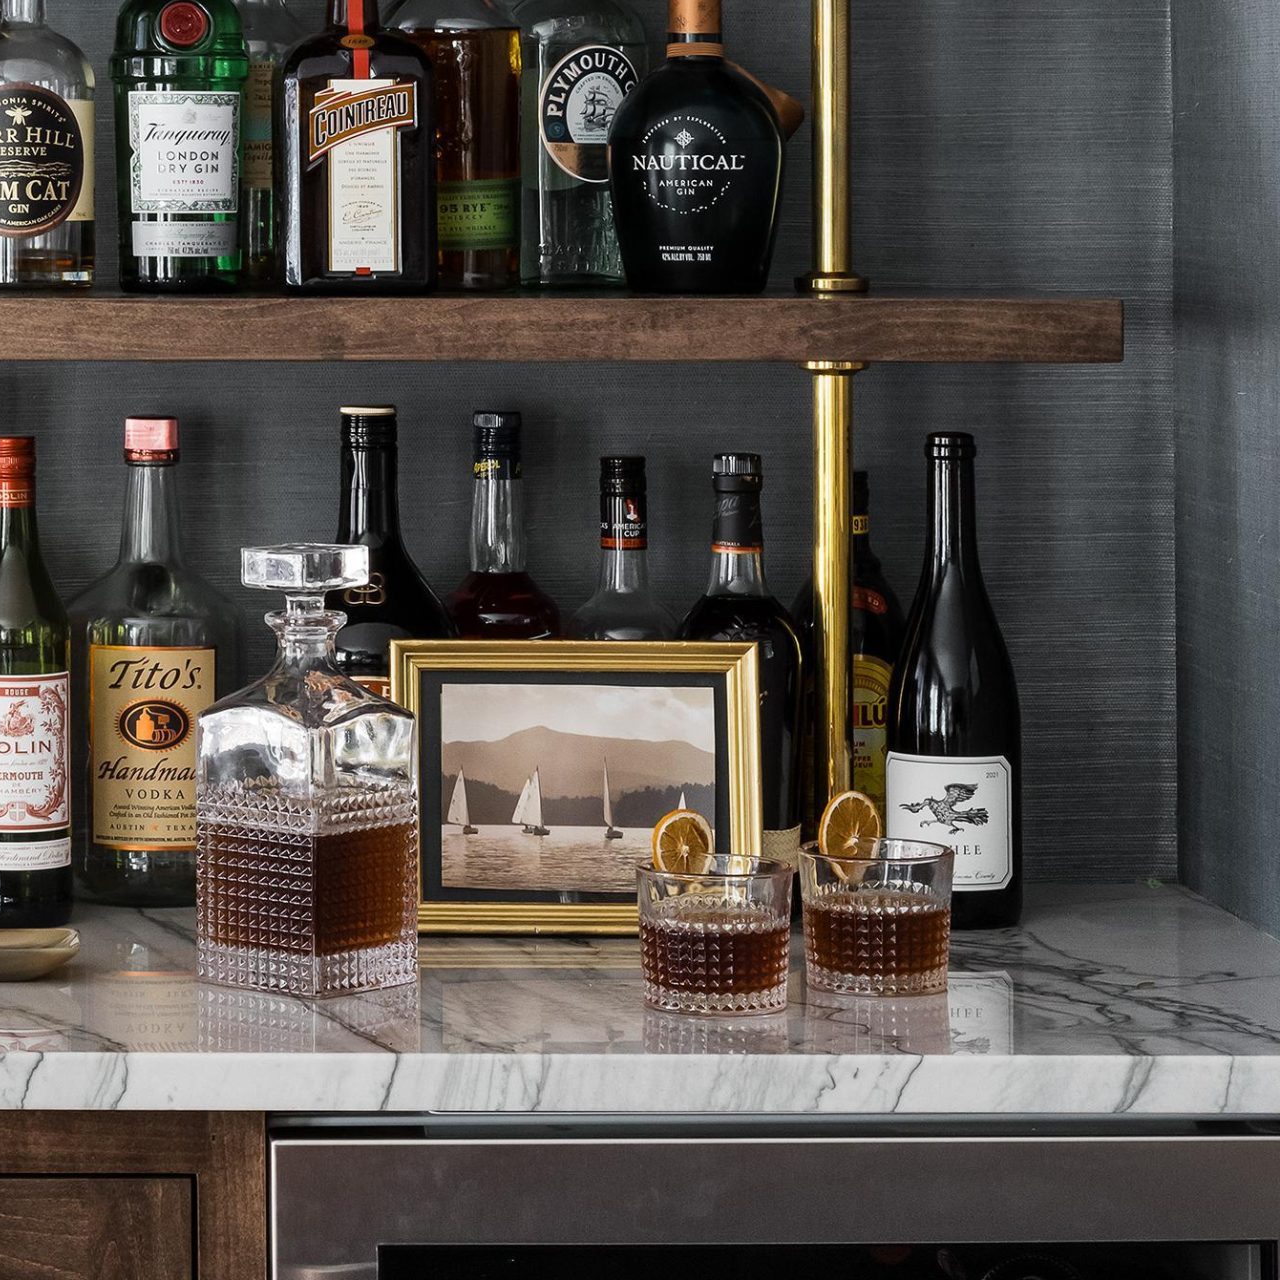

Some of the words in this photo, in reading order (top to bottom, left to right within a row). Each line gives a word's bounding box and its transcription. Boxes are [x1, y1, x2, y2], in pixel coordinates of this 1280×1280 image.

[547, 52, 628, 117] PLYMOUTH
[32, 99, 66, 122] SPIRITS
[313, 92, 410, 147] COINTREAU
[25, 126, 75, 149] HILL
[144, 122, 231, 146] Tanqueray
[158, 151, 220, 161] LONDON
[632, 154, 744, 171] NAUTICAL
[158, 164, 188, 174] DRY
[194, 164, 220, 174] GIN
[25, 179, 70, 201] CAT
[676, 188, 696, 196] GIN
[8, 204, 29, 213] GIN
[440, 204, 459, 214] 95
[463, 203, 488, 213] RYE
[7, 219, 37, 227] AMERICAN
[98, 757, 197, 781] Handma
[125, 789, 185, 800] VODKA
